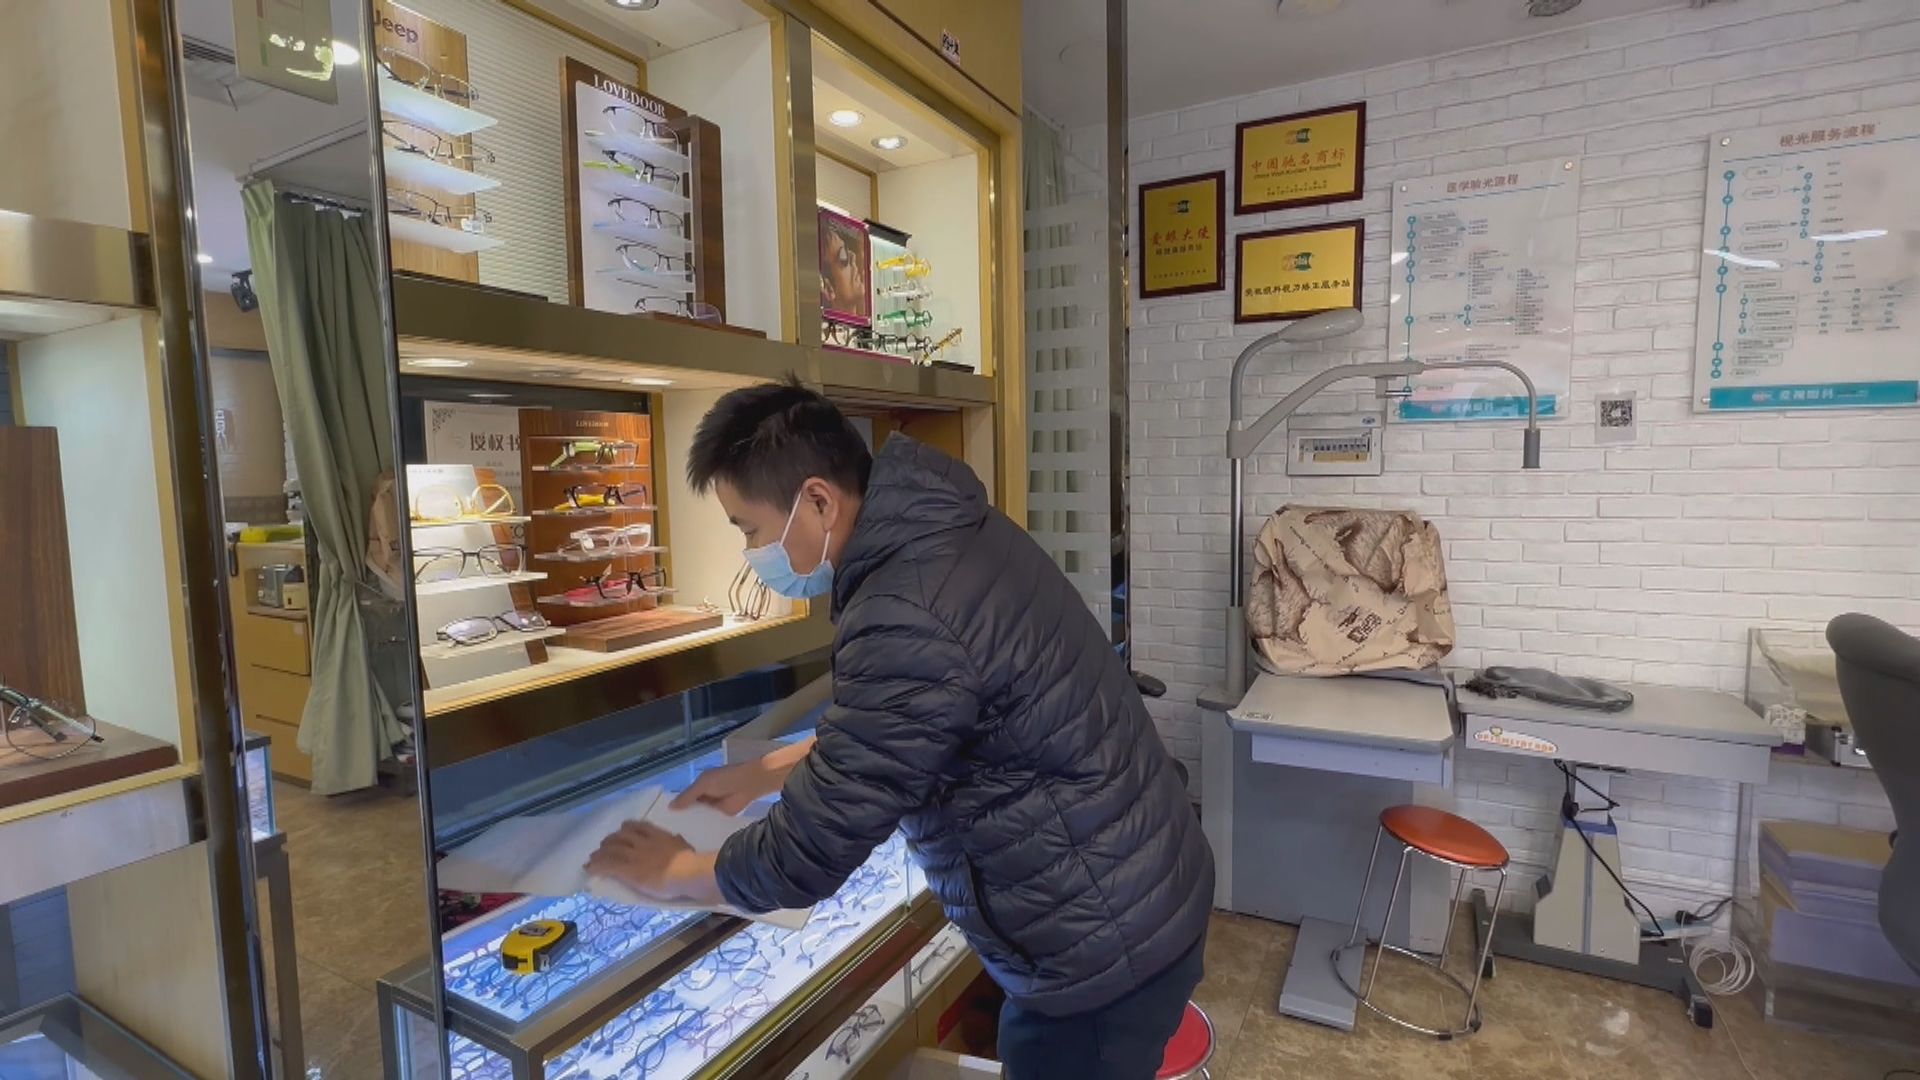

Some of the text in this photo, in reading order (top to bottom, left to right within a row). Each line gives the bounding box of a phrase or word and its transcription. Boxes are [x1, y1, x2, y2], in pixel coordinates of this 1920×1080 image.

[373, 9, 419, 44] Jeep
[593, 74, 666, 118] LOVEDOOR
[1779, 123, 1876, 148] 视光服务流程
[1251, 147, 1346, 173] 中国驰名商标
[1446, 173, 1519, 194] 医学验光流程
